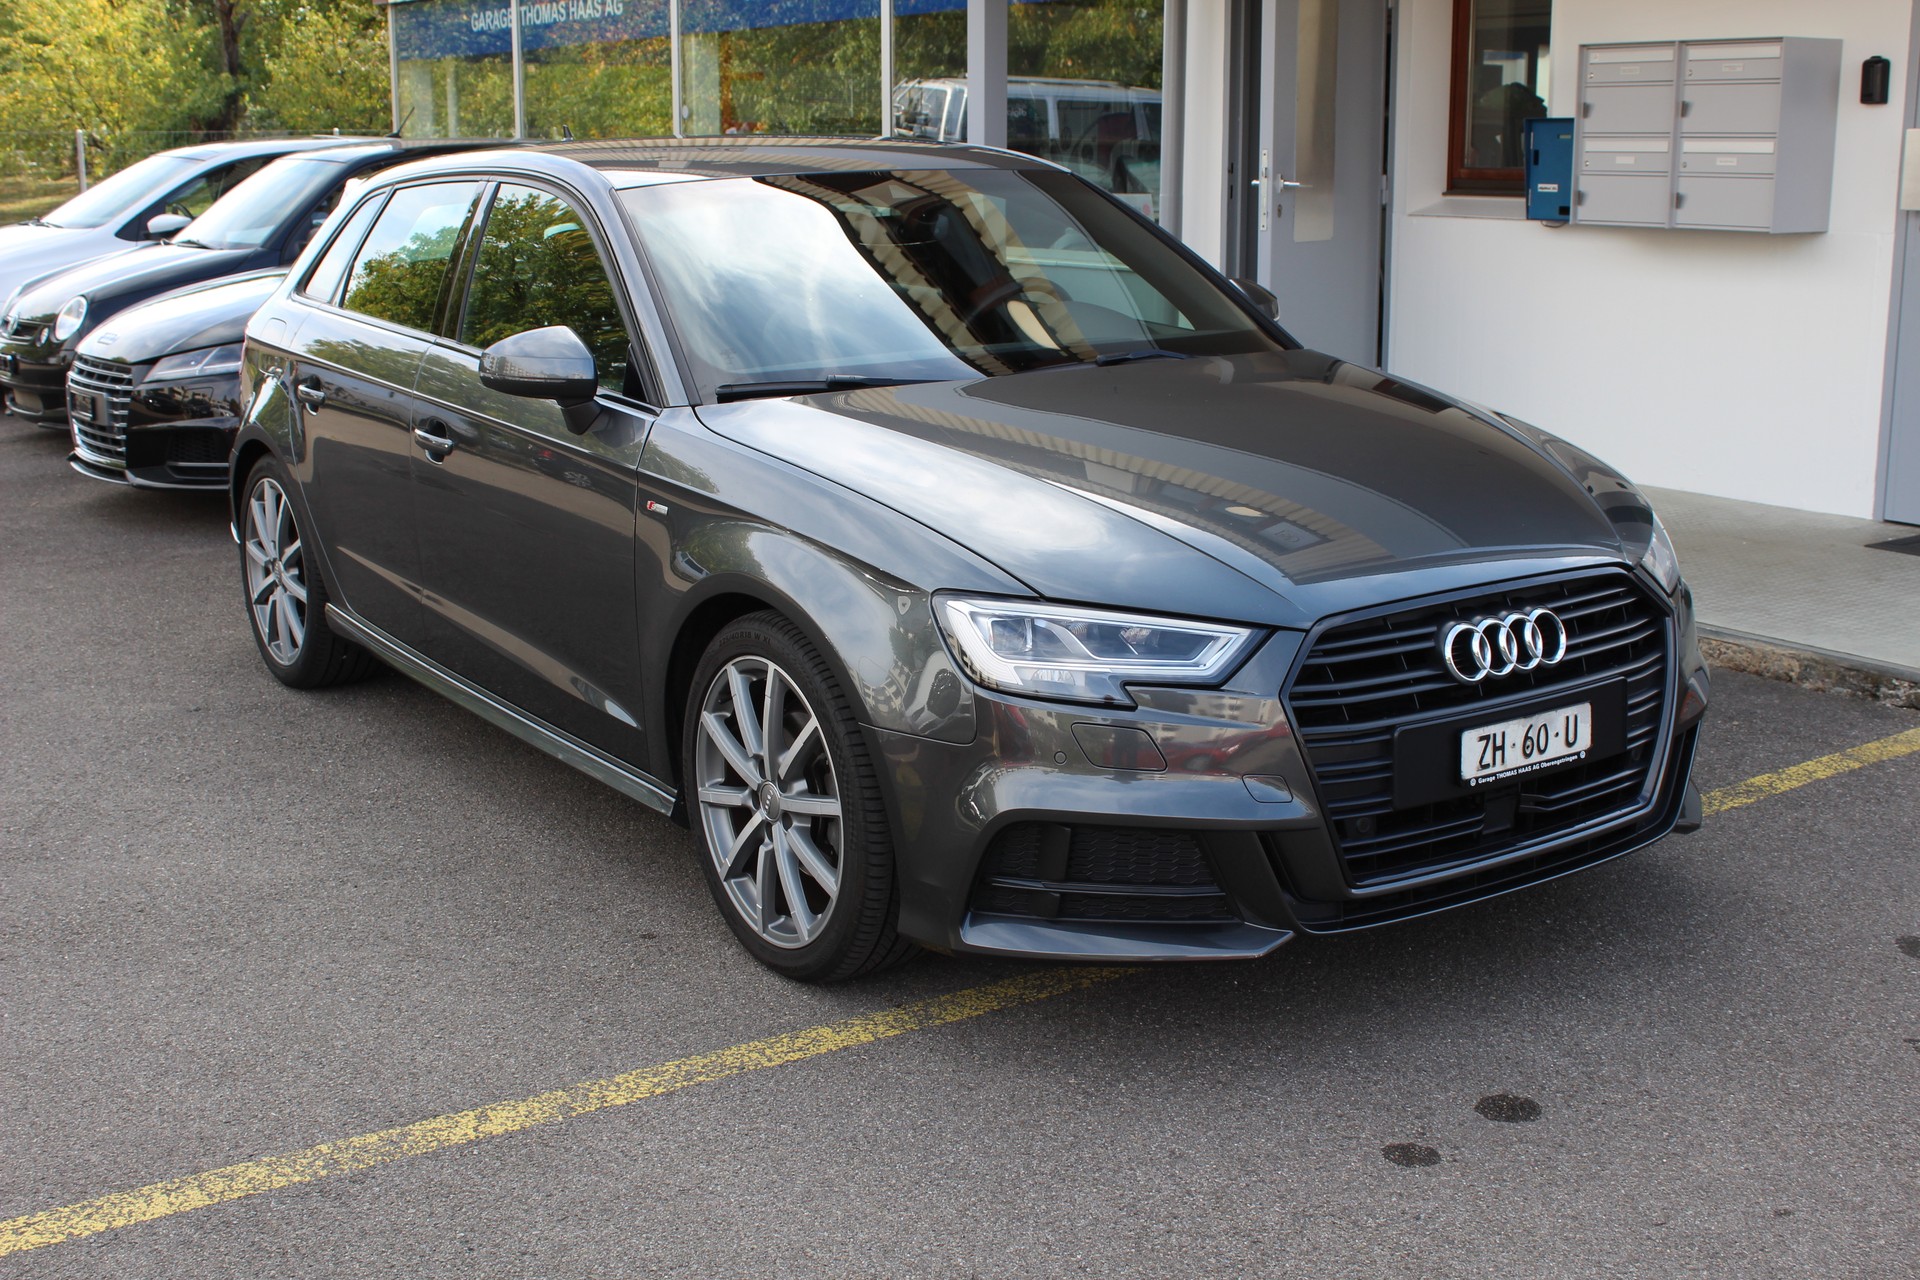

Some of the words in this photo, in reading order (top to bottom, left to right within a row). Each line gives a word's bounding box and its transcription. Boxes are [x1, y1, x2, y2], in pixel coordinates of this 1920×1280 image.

[471, 8, 513, 32] GARAGE
[520, 4, 566, 26] THOMAS
[569, 0, 602, 20] HAAS
[605, 0, 623, 16] AG
[1477, 731, 1506, 770] ZH
[1522, 723, 1549, 759] 60
[1565, 713, 1578, 748] U
[1478, 775, 1496, 785] Garage
[1496, 769, 1518, 779] THOMAS
[1518, 765, 1532, 774] HAAS
[1532, 763, 1540, 771] AG
[1540, 754, 1578, 769] Oberengstringen
